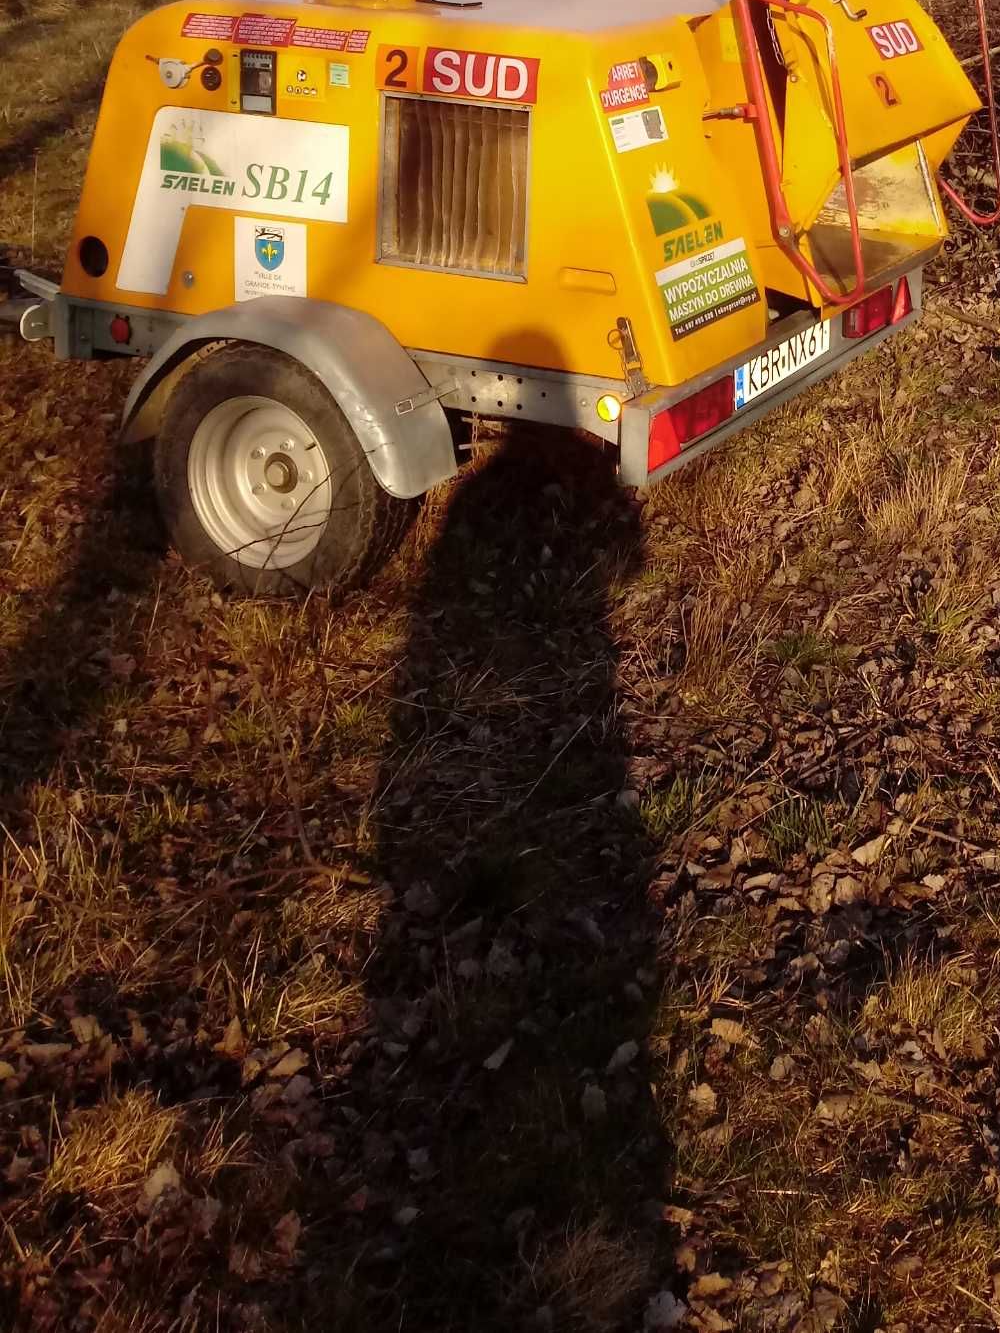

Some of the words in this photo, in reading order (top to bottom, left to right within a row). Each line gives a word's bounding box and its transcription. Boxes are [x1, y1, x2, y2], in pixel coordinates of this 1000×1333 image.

[871, 21, 918, 59] SUD
[385, 49, 409, 88] 2
[431, 50, 529, 100] SUD
[611, 62, 640, 82] ARRET
[875, 75, 898, 106] 2
[600, 83, 649, 107] D'URGENCE
[160, 173, 236, 196] SAELEN
[241, 163, 334, 206] SB14
[663, 221, 724, 263] SAELEN
[663, 257, 749, 305] WYPOŻYCZALNIA
[668, 295, 705, 322] MASZYN
[704, 289, 719, 306] DO
[719, 274, 754, 299] DREWNA
[748, 348, 781, 396] KBR
